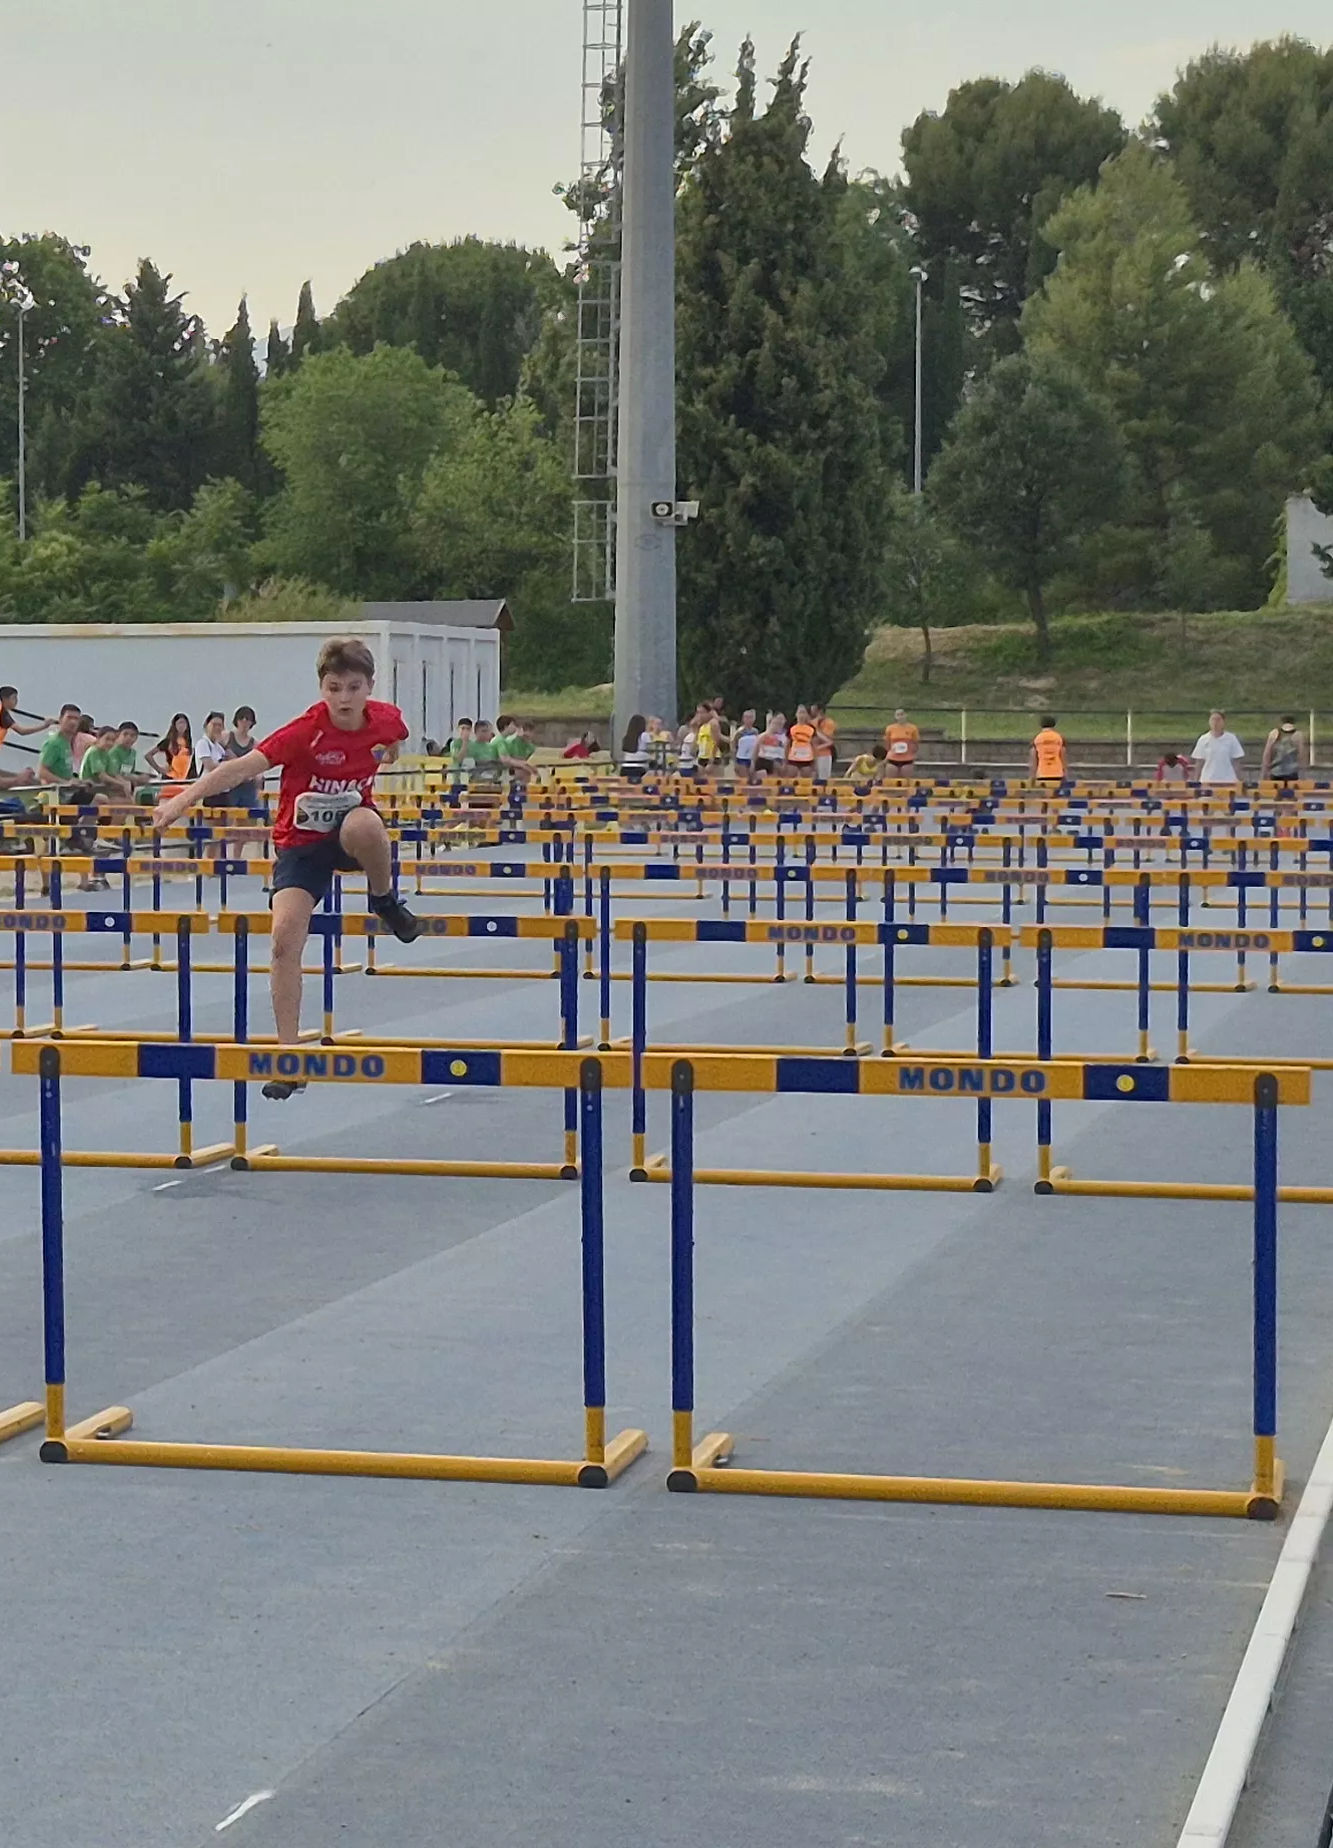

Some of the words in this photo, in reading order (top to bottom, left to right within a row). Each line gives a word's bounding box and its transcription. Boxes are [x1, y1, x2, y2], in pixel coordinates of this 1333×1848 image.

[695, 868, 757, 879] MONDO
[985, 871, 1049, 882] MONDO
[1284, 874, 1333, 886] MOND
[769, 926, 856, 941] MONDO
[1179, 932, 1270, 948] MONDO
[248, 1052, 385, 1078] MONDO
[898, 1066, 1046, 1094] MONDO
